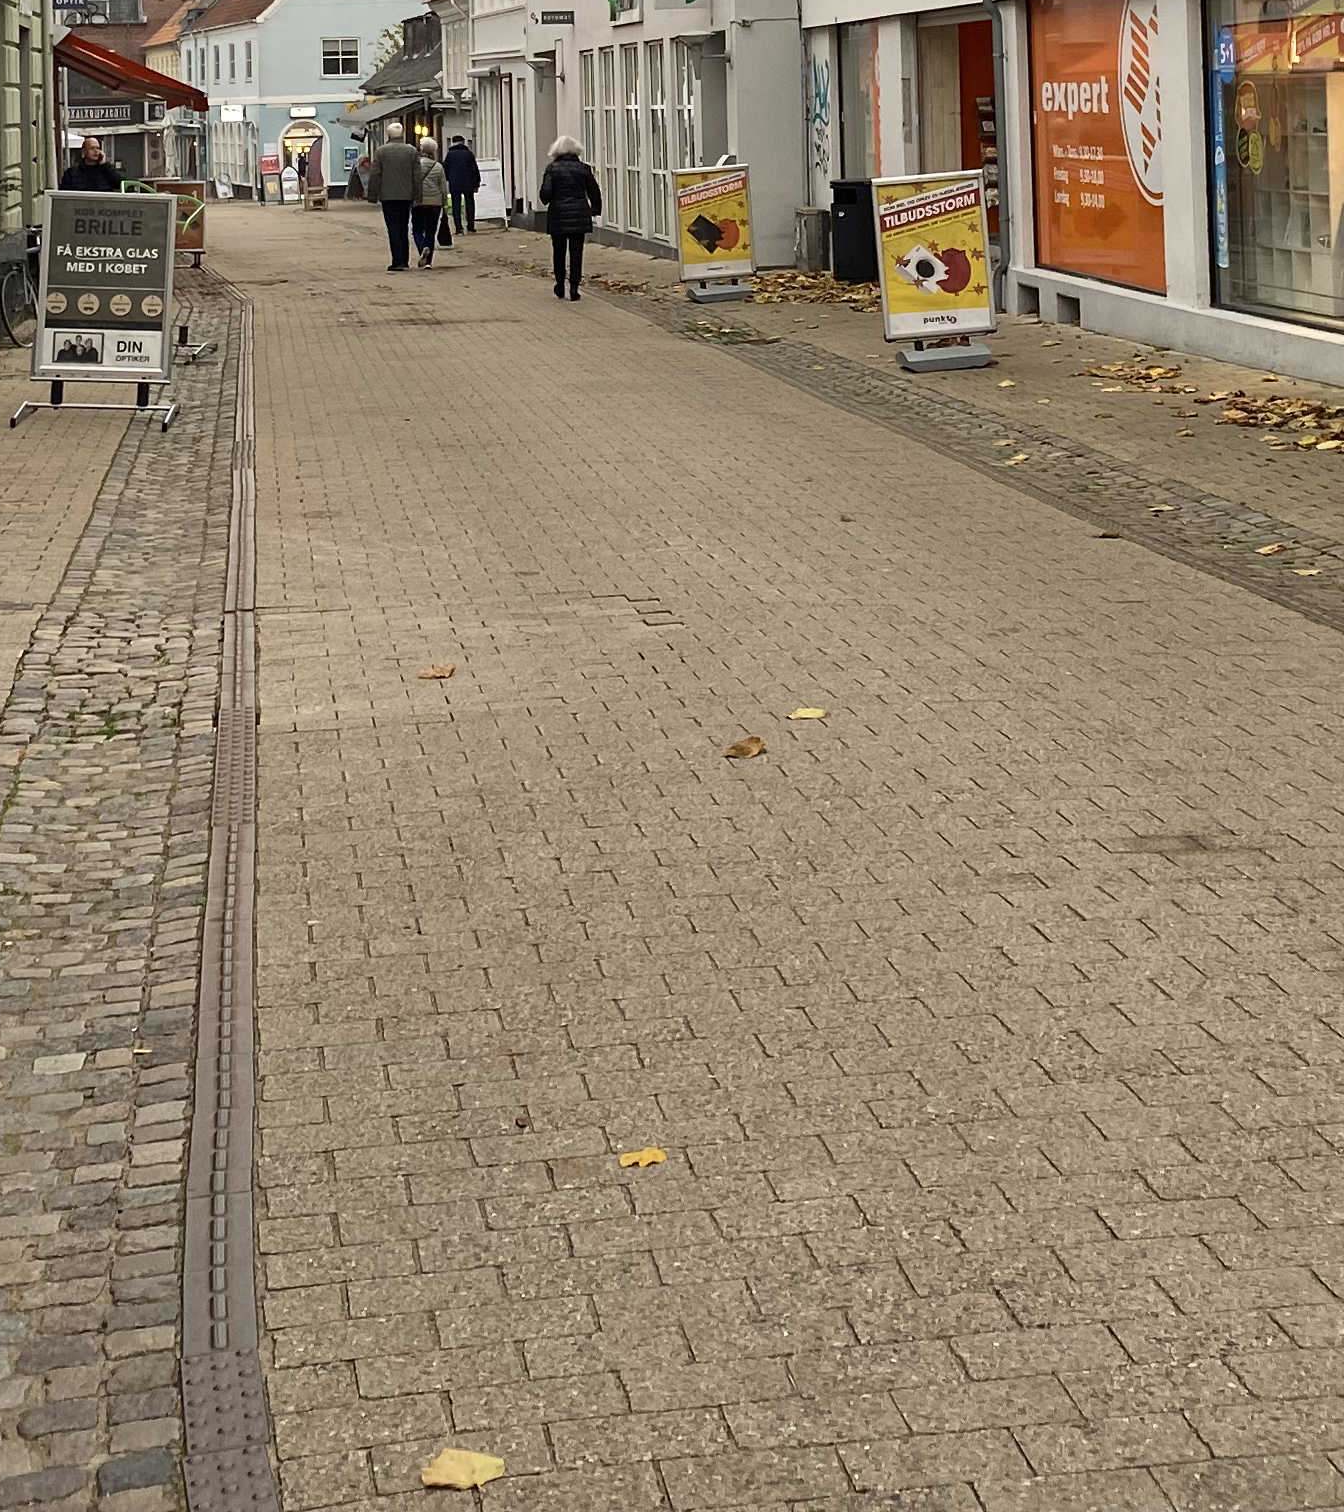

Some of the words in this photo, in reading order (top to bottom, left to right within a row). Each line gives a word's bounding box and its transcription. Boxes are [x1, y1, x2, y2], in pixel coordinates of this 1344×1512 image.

[1041, 75, 1110, 121] expert
[680, 179, 743, 206] TILBUDSSTORM
[884, 192, 976, 228] TILBUDSSTORM
[74, 219, 144, 236] BRILLE
[57, 243, 73, 256] FÅ
[76, 246, 123, 258] EKSTRA
[126, 248, 158, 259] GLAS
[66, 262, 95, 272] MED
[98, 263, 102, 273] I
[105, 263, 148, 274] KØBET
[923, 315, 952, 325] punkt
[117, 340, 143, 353] DIN
[116, 354, 150, 363] OPTIKER
